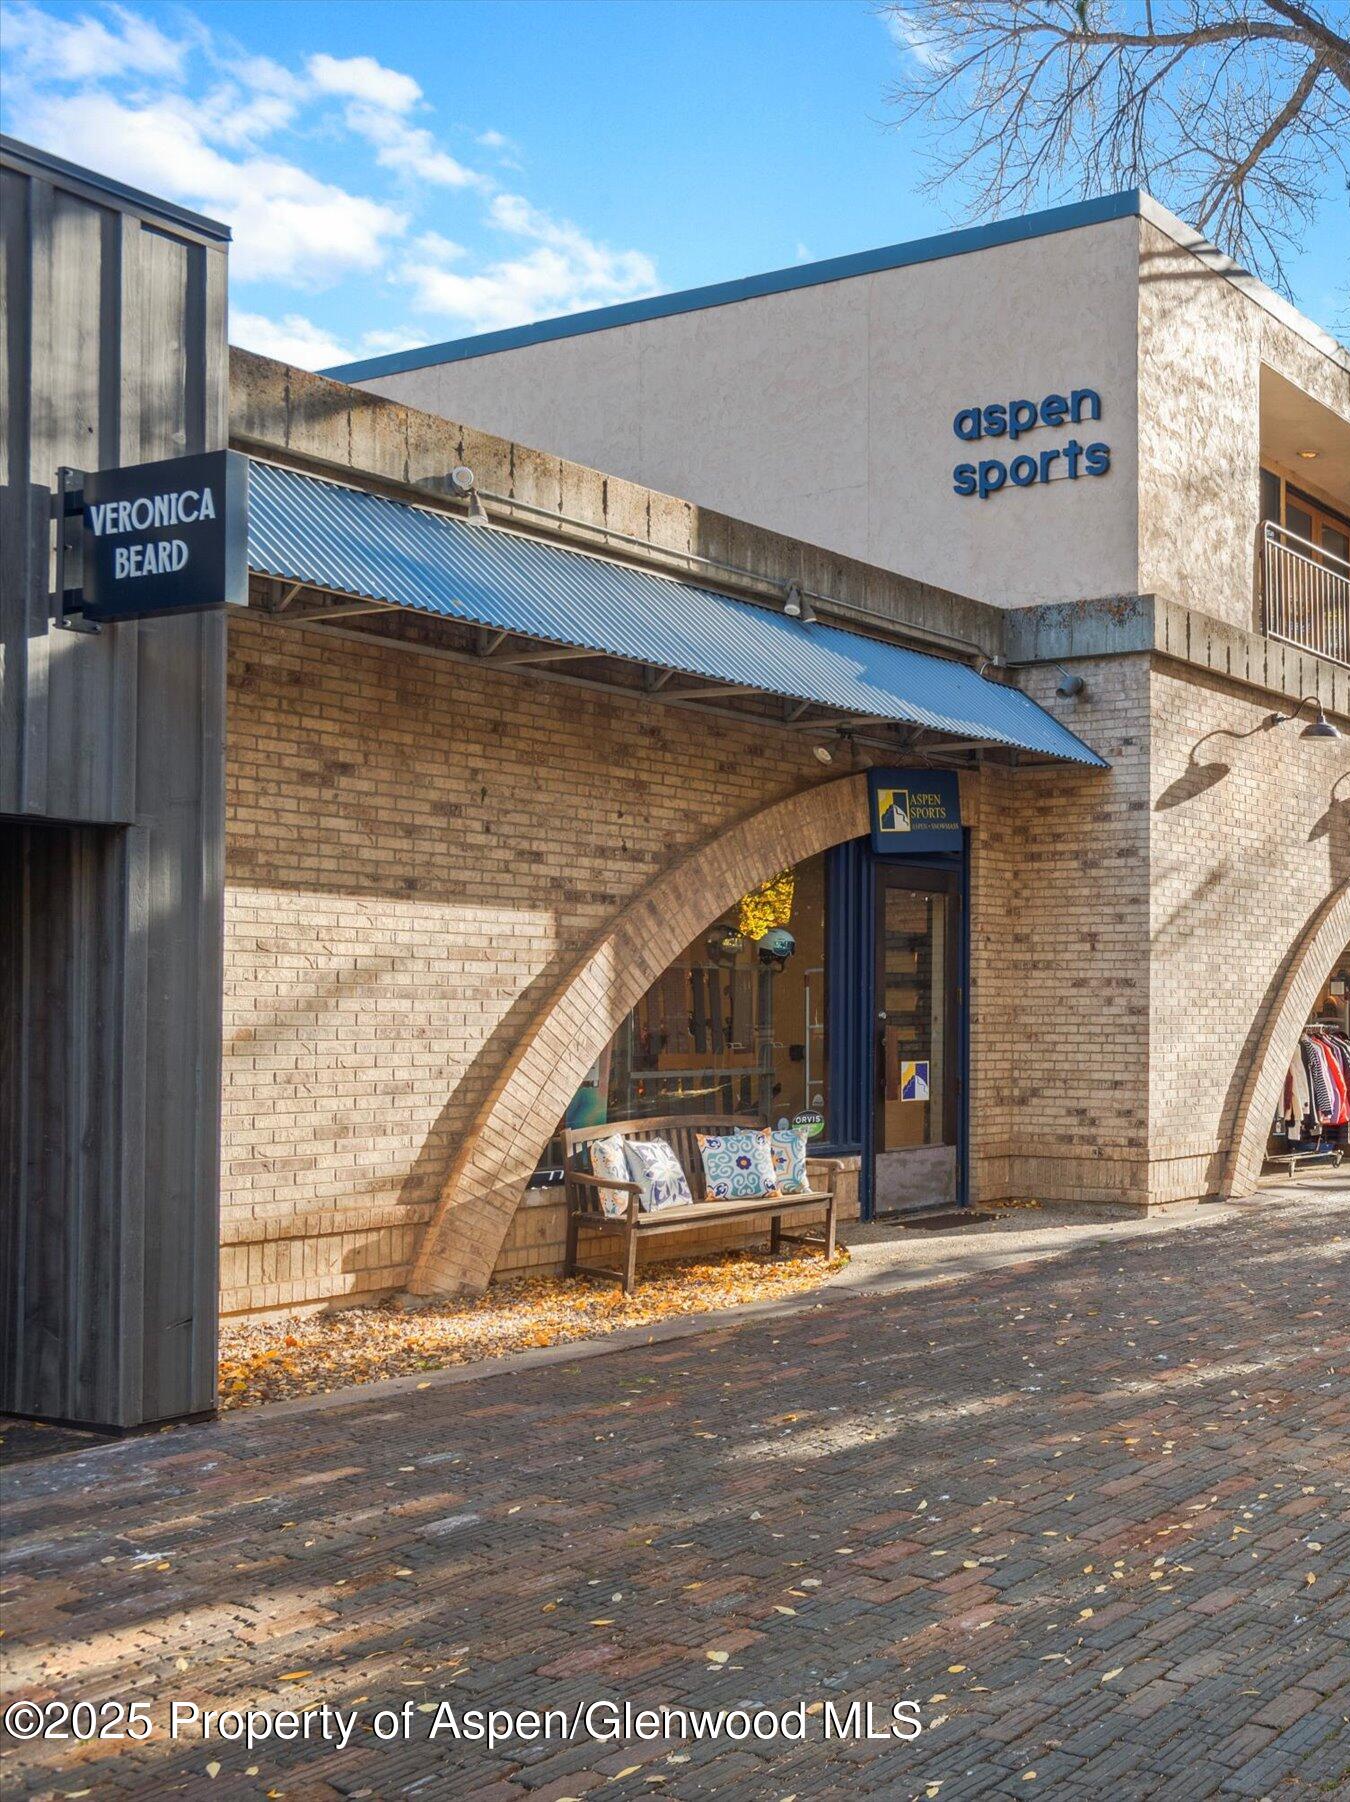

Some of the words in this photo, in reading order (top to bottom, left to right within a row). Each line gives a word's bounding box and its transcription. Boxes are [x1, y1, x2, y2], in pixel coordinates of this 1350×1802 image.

[953, 388, 1102, 440] aspen
[953, 439, 1111, 499] sports
[90, 487, 216, 536] VERONICA
[114, 539, 189, 580] BEARD
[910, 793, 942, 805] ASPEN
[910, 807, 947, 819] SPORTS
[795, 1115, 821, 1124] ORVIS
